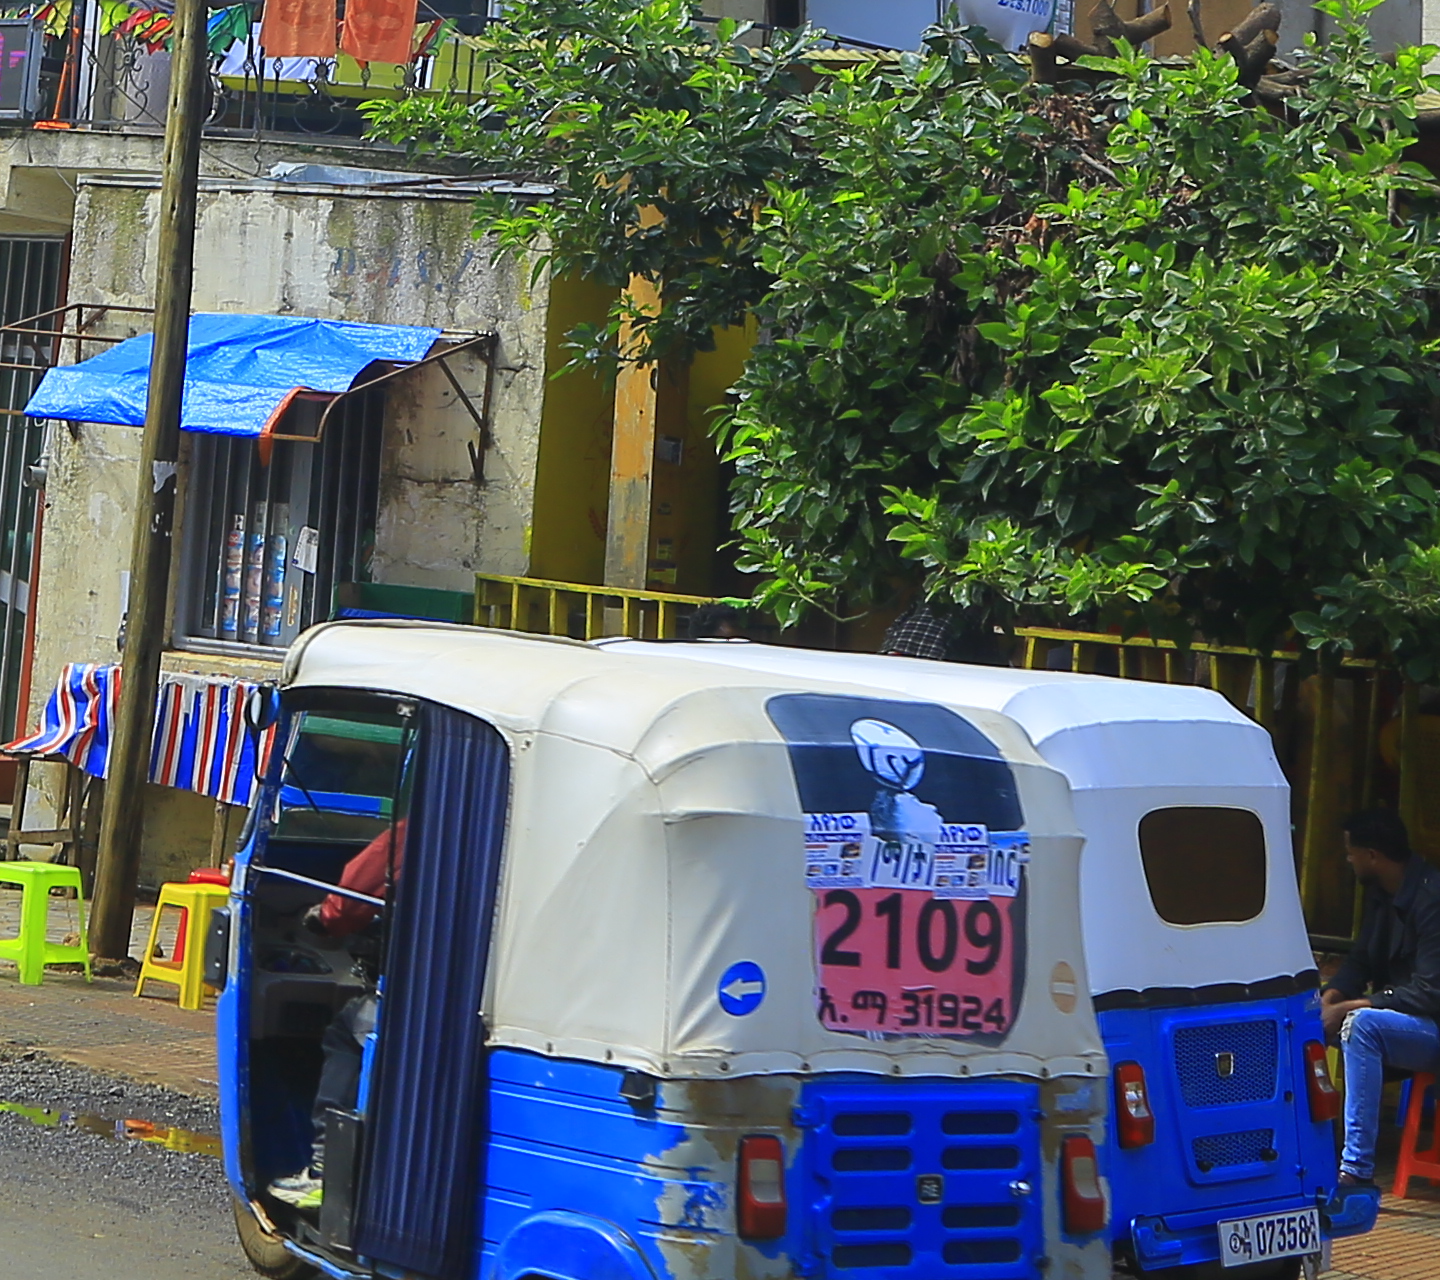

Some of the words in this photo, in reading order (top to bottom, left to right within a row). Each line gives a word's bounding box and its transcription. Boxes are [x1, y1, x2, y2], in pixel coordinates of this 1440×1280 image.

[821, 889, 1003, 976] 2109
[899, 990, 1006, 1031] 31924
[1256, 1214, 1310, 1256] 07358
